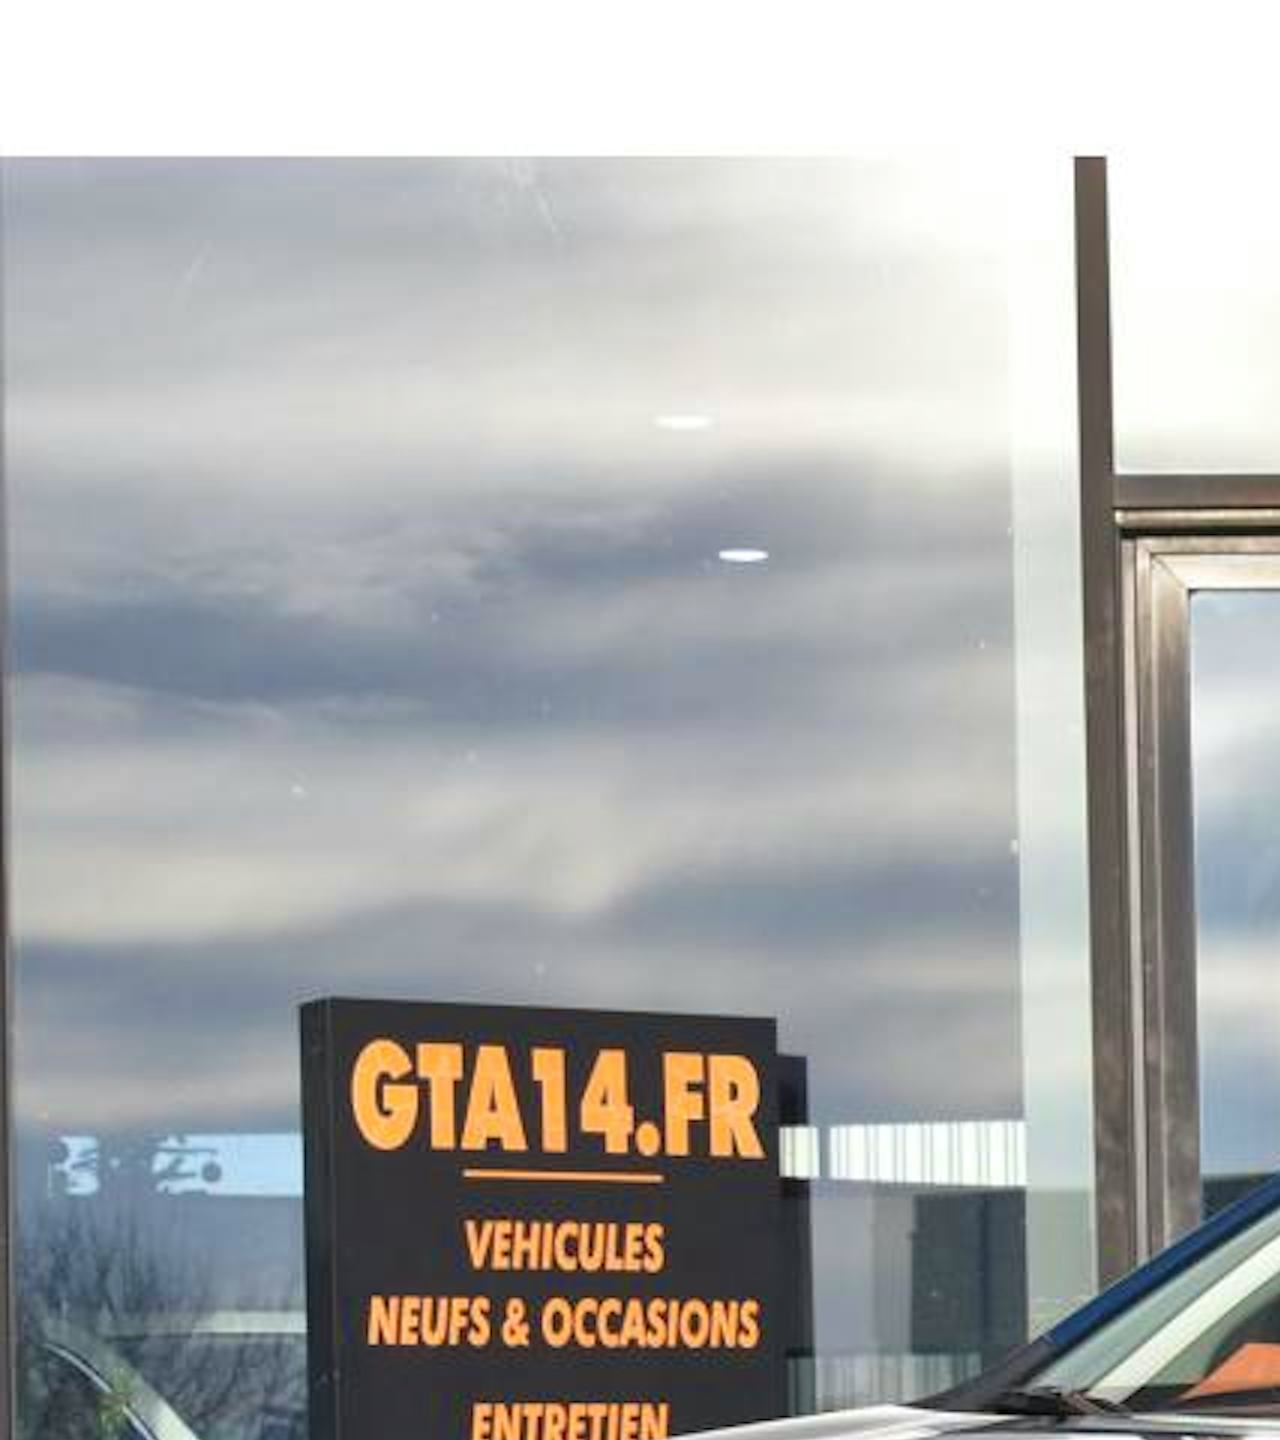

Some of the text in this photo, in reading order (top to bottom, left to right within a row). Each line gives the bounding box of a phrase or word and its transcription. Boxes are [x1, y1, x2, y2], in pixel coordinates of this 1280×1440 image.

[350, 1037, 767, 1159] GTA14.FR
[465, 1219, 666, 1274] VEHICULES
[367, 1294, 761, 1349] NEUFS & OCCASIONS
